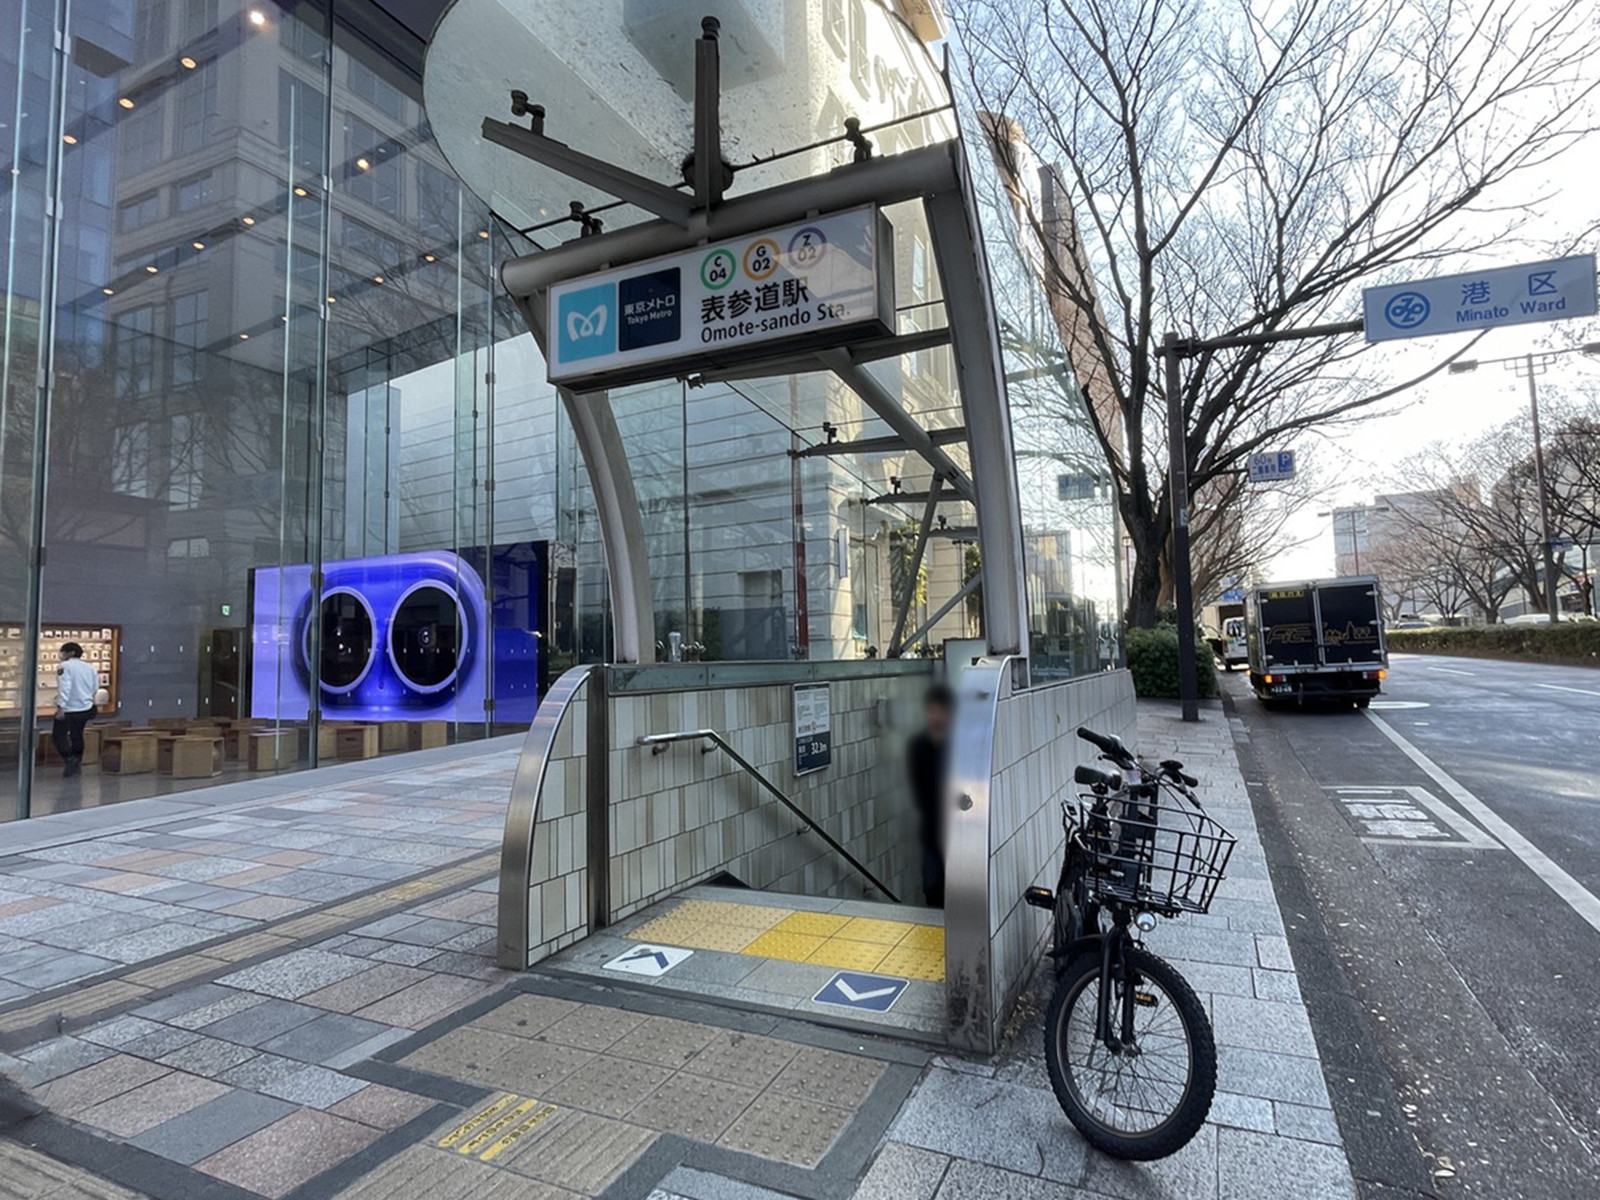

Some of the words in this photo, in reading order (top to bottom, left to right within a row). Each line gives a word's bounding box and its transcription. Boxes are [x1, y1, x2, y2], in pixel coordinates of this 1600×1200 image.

[802, 233, 811, 247] Z
[756, 245, 767, 258] G
[797, 246, 817, 262] 02
[713, 255, 722, 268] C
[752, 257, 771, 273] 02
[709, 267, 728, 283] 04
[623, 294, 676, 316] 東京メトロ
[701, 276, 810, 325] 表参道駅
[627, 313, 648, 325] Tokyo
[649, 308, 673, 321] Metro
[1456, 305, 1509, 324] Minato
[1519, 297, 1566, 315] Ward
[701, 307, 811, 344] Omote-sando
[816, 302, 851, 322] Sta.
[1282, 453, 1290, 465] P
